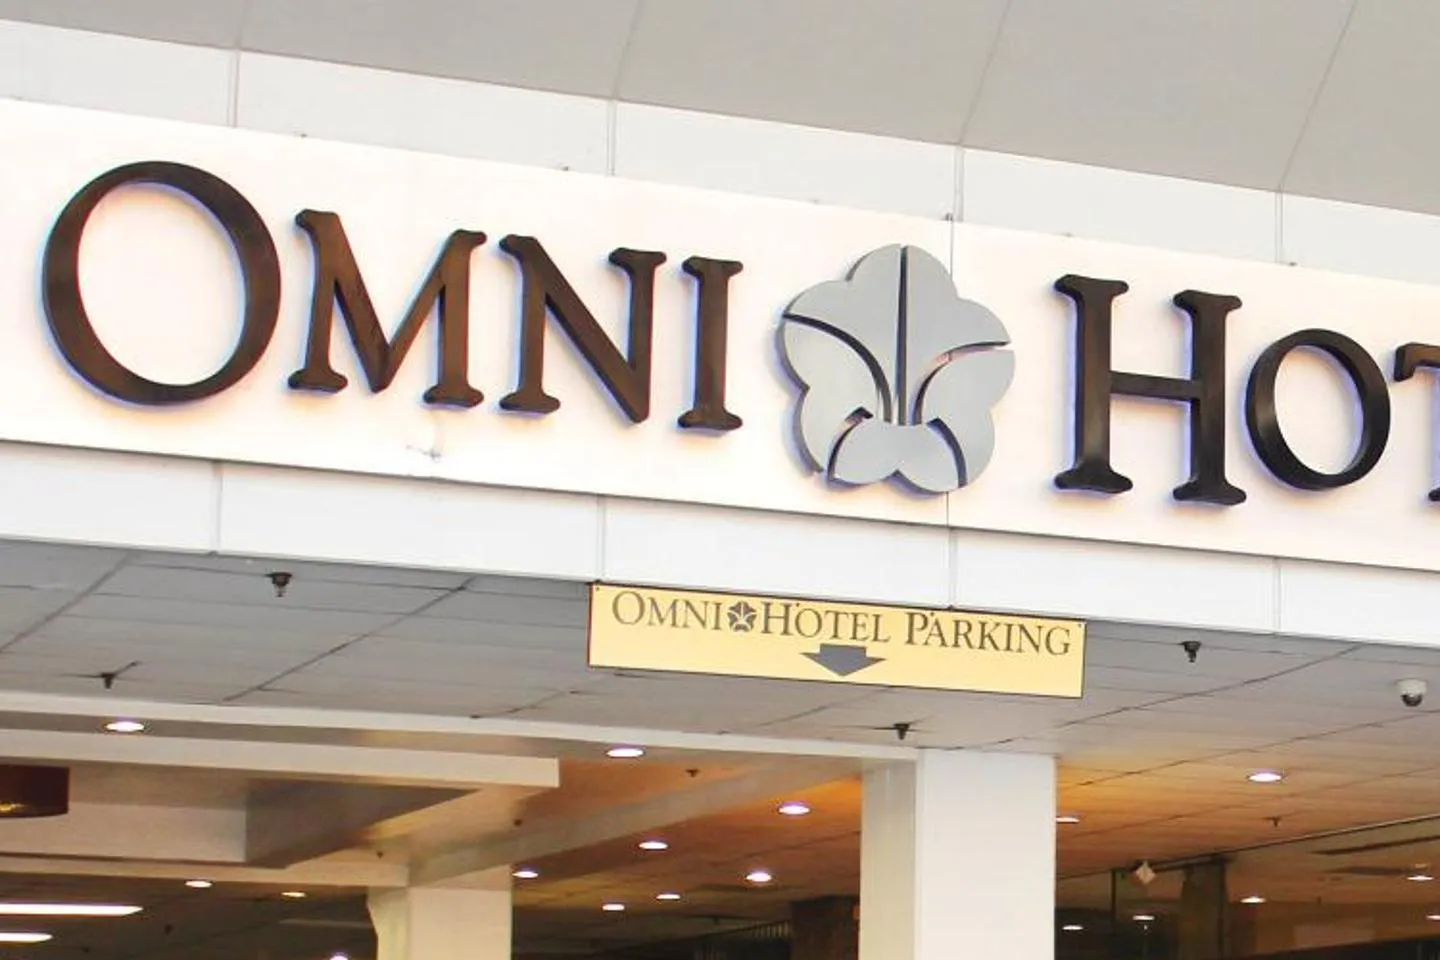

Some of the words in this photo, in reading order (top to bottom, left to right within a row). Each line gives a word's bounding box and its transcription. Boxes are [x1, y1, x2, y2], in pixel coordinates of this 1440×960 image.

[40, 159, 743, 432] OMNI
[612, 590, 722, 631] OMNI
[762, 601, 890, 643] HOTEL
[906, 612, 1072, 656] PARKING
